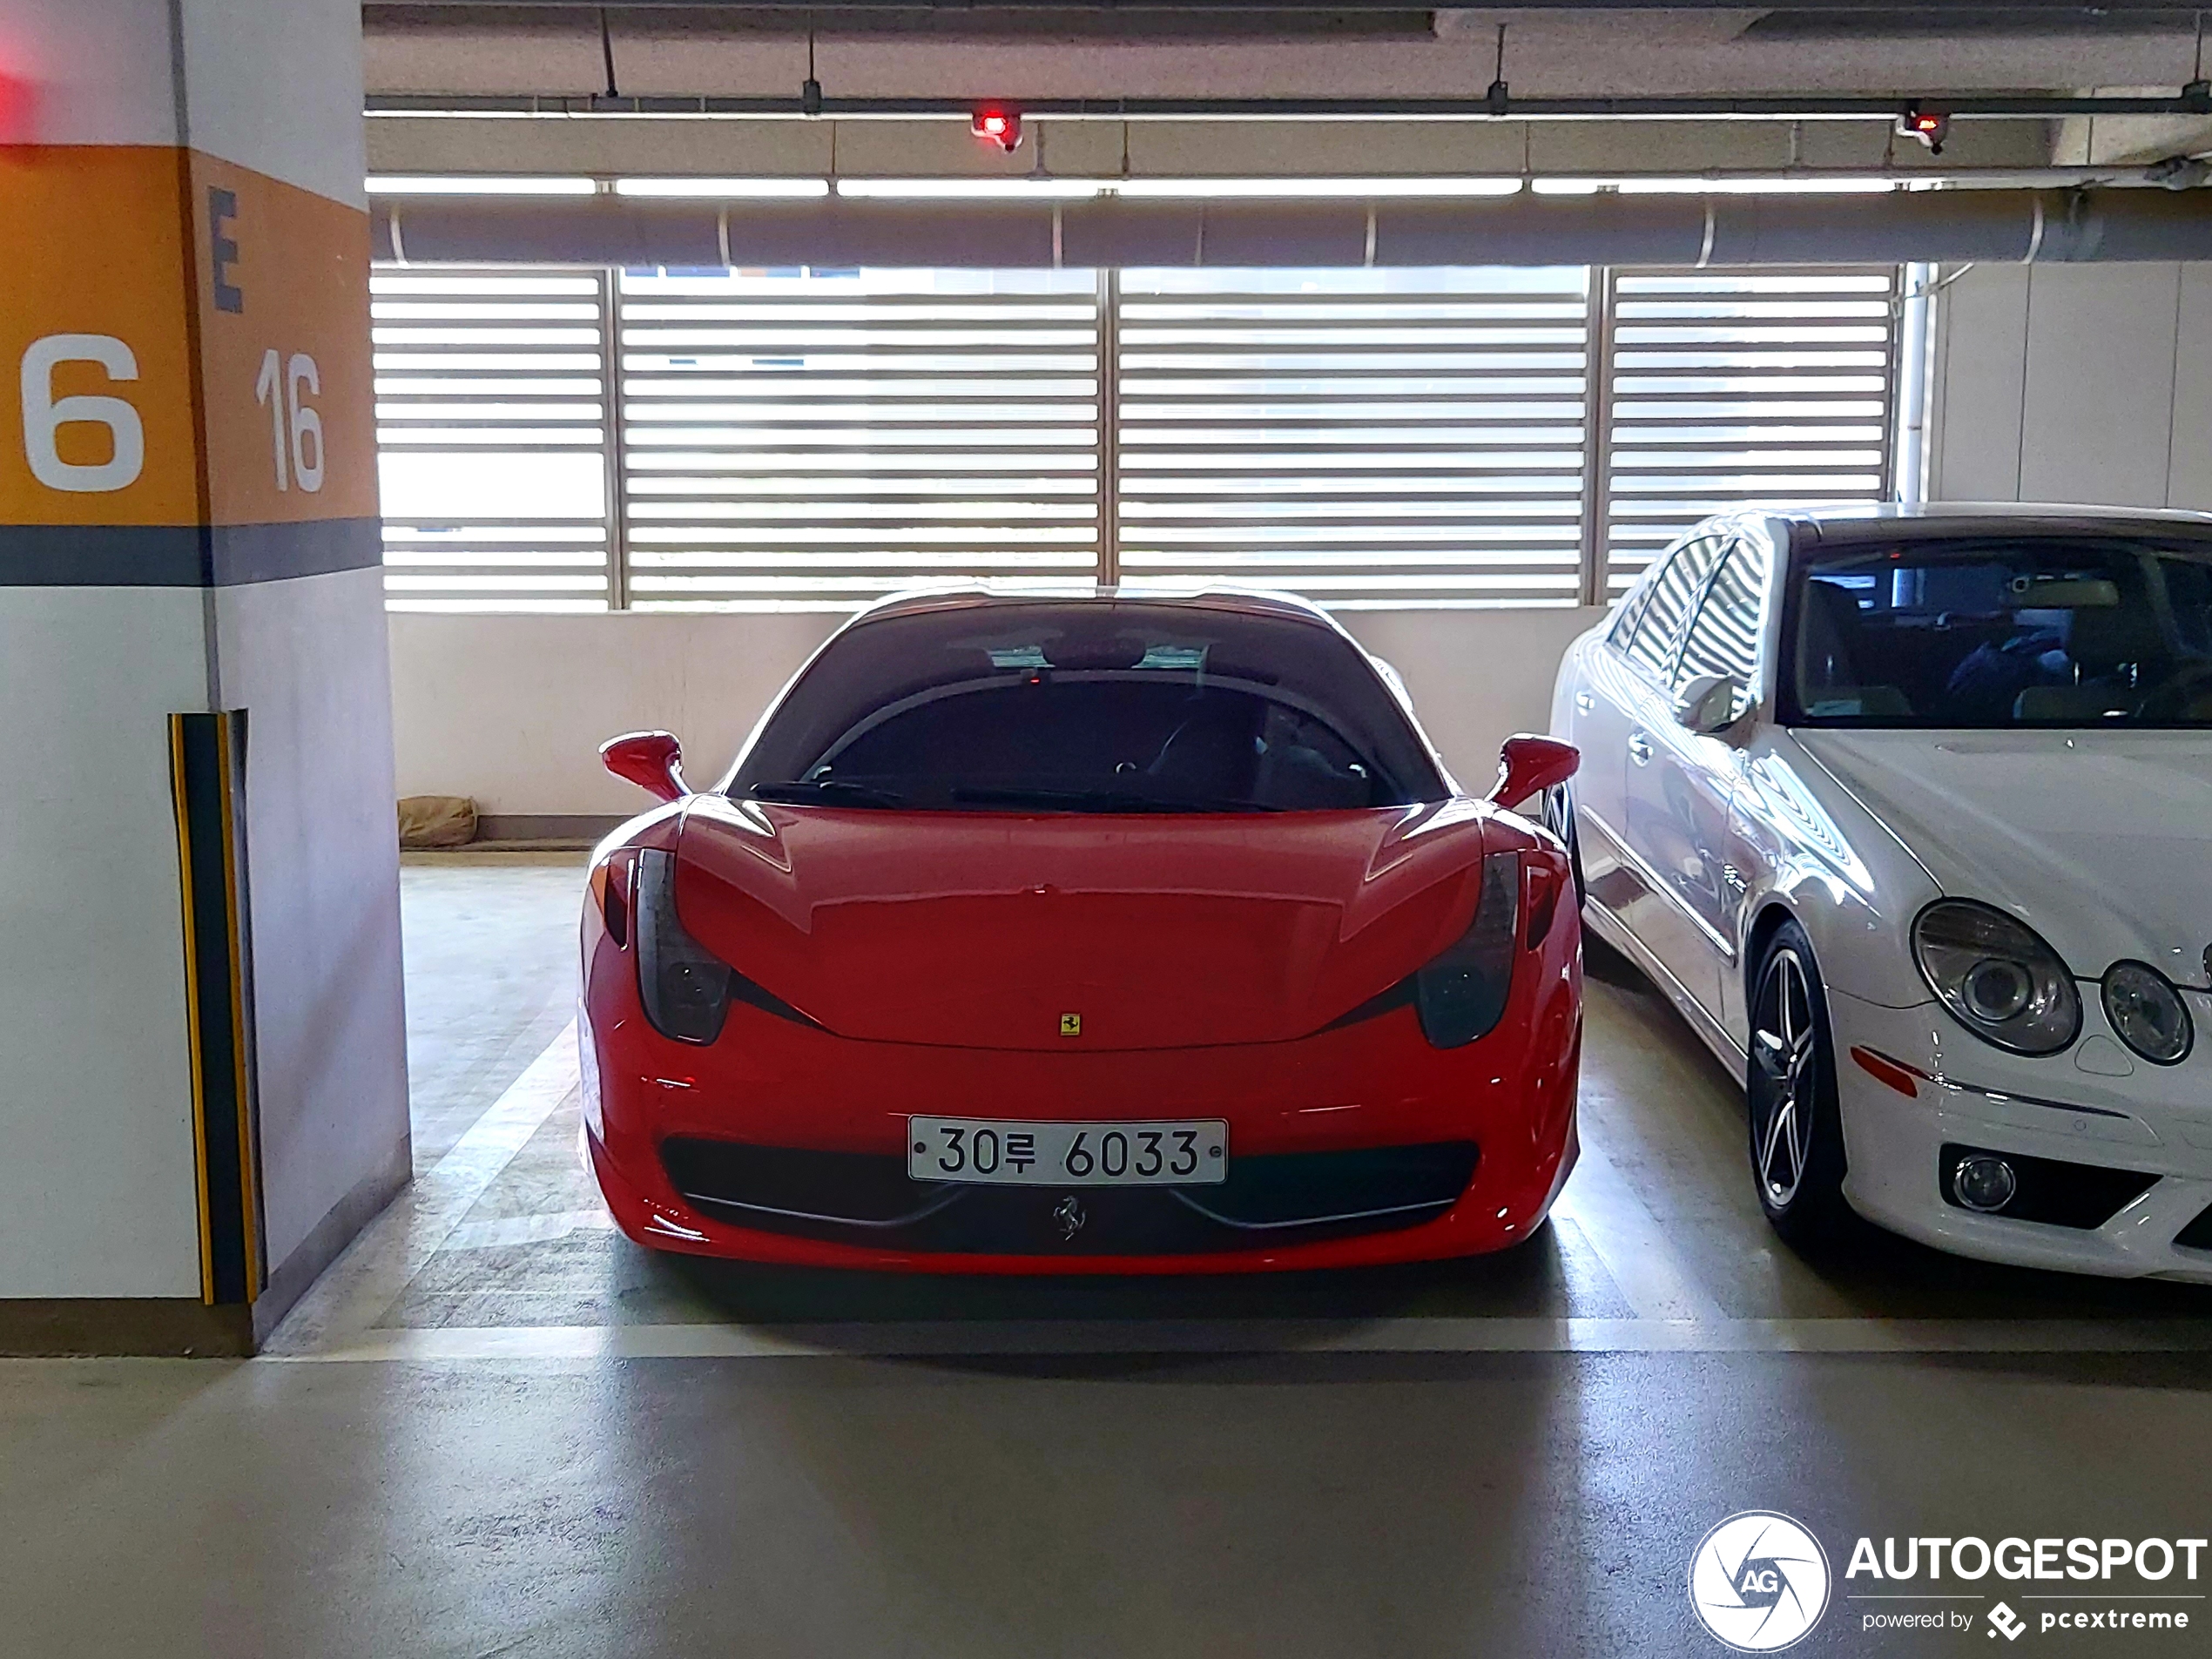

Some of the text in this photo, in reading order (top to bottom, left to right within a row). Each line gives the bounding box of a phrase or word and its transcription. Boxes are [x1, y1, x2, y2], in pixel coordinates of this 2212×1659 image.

[208, 185, 244, 314] E
[255, 348, 325, 494] 16
[937, 1127, 1198, 1177] 30루 6033
